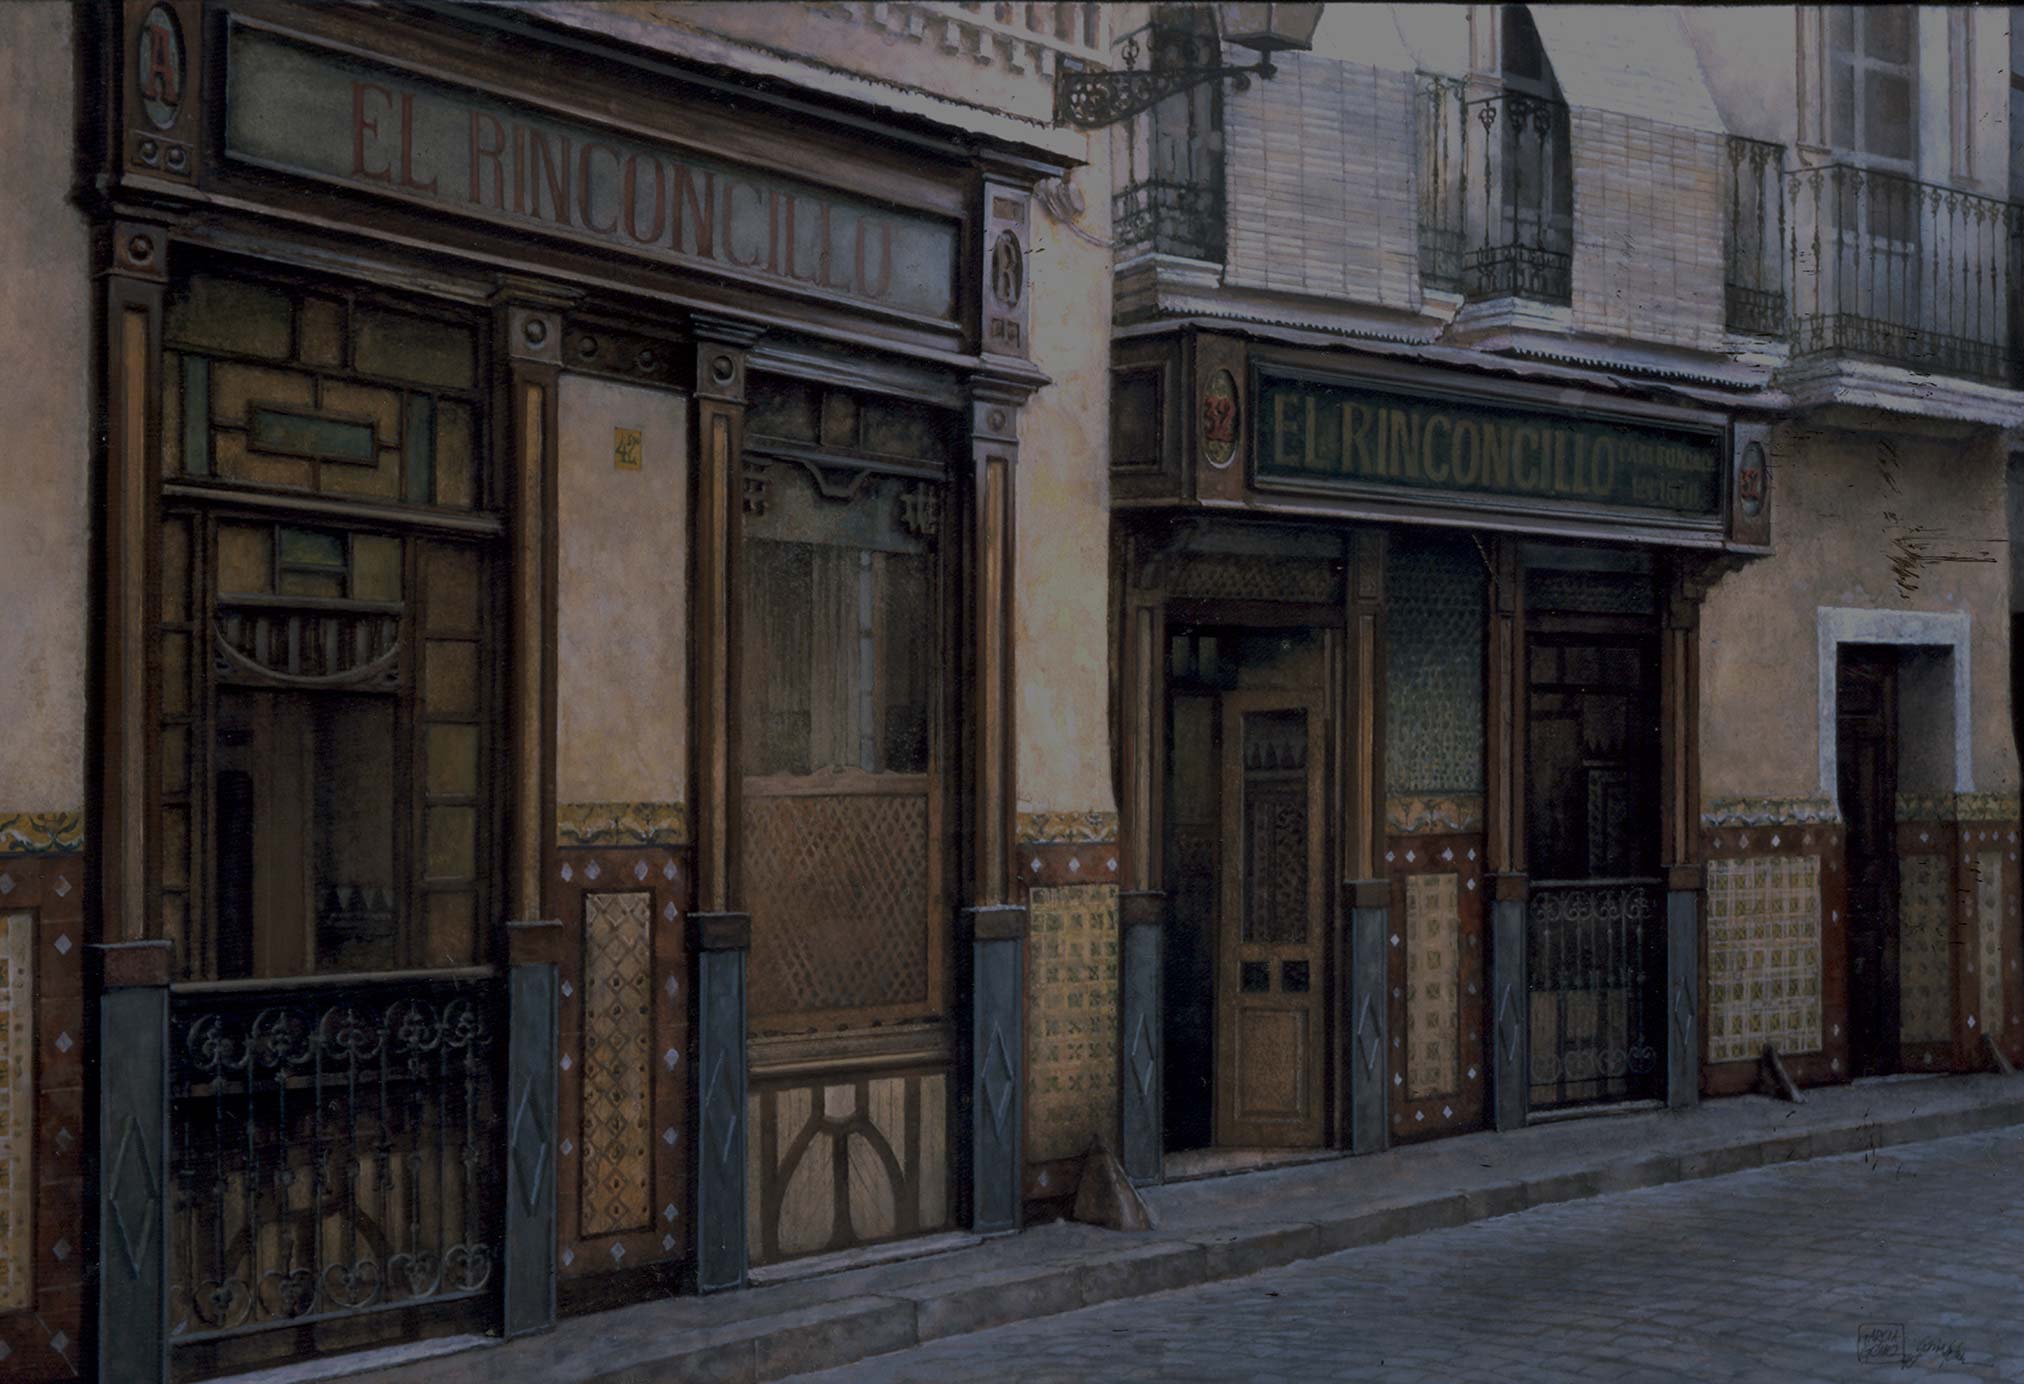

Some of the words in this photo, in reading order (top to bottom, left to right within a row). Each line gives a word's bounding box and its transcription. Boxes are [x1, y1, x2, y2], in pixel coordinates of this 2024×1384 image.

[143, 24, 179, 106] A
[351, 80, 438, 195] EL
[468, 109, 893, 298] RINCONCILLO
[1273, 392, 1330, 469] EL
[1341, 400, 1617, 498] RINCONCILLO
